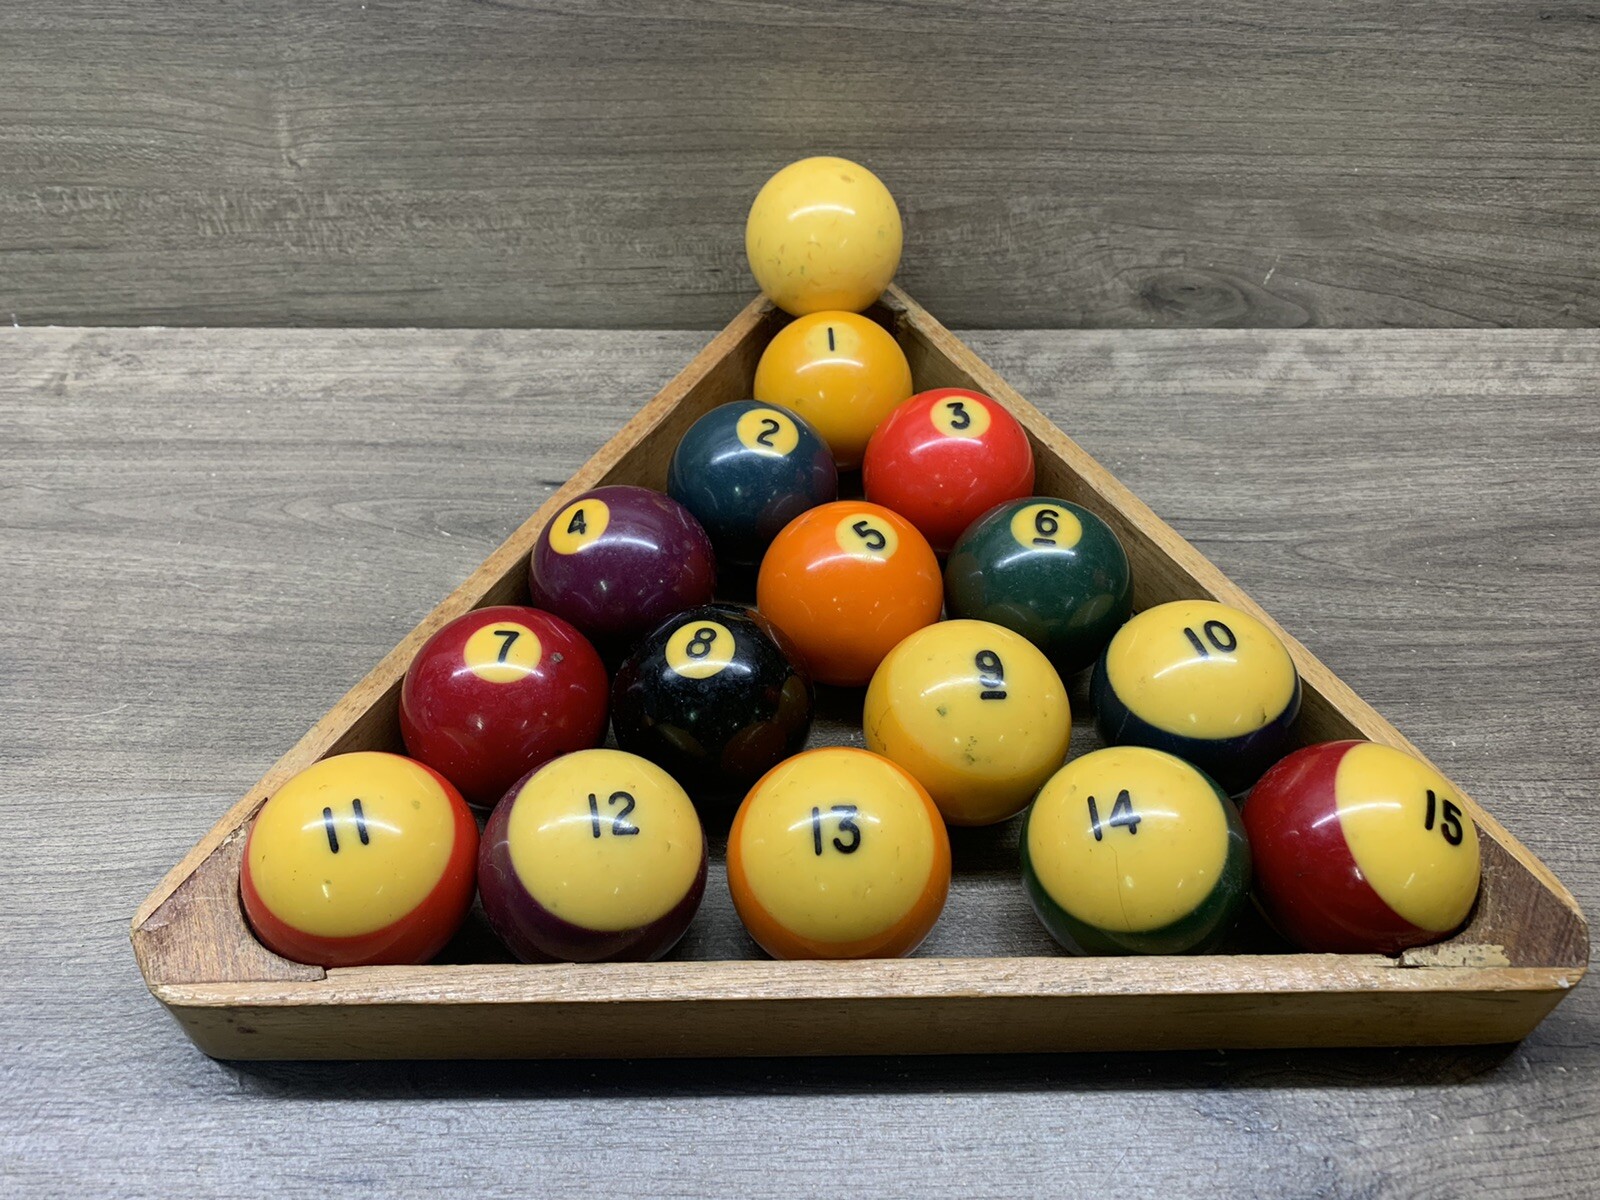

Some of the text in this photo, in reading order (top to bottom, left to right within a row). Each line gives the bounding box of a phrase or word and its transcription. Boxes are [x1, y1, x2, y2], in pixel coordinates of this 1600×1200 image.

[827, 326, 836, 352] 1
[757, 418, 781, 447] 2
[946, 402, 971, 430] 3
[567, 507, 587, 535] 4
[852, 520, 886, 550] 5
[1034, 508, 1059, 538] 6
[494, 630, 520, 663] 7
[685, 627, 717, 659] 8
[1183, 620, 1238, 659] 10
[975, 649, 1007, 689] 9
[323, 798, 370, 854] 11
[588, 791, 640, 838] 12
[813, 805, 862, 857] 13
[1087, 789, 1141, 842] 14
[1424, 789, 1464, 847] 15
